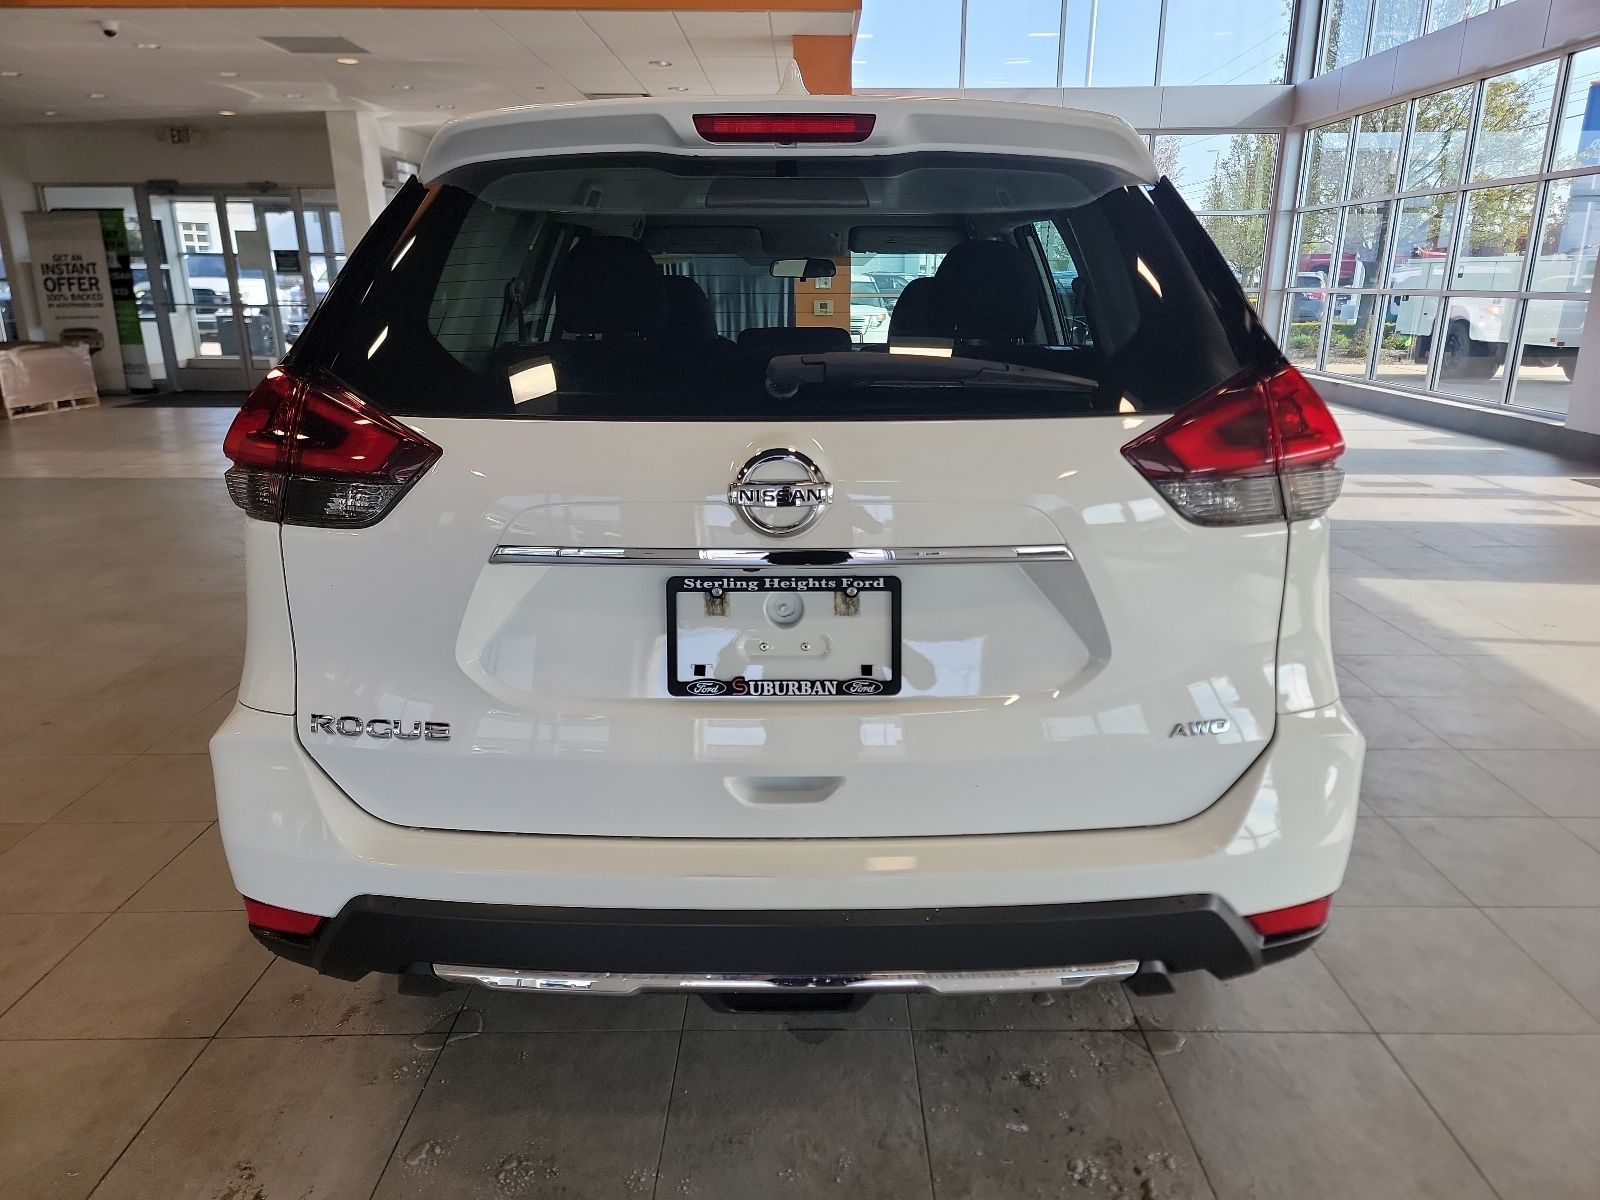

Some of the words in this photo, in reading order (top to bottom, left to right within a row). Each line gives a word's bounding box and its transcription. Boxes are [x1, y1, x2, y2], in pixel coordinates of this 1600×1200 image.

[40, 262, 97, 275] INSTANT
[43, 277, 101, 292] OFFER
[739, 488, 822, 503] NISSAN
[683, 578, 759, 590] Sterling
[763, 578, 836, 590] Heights
[841, 577, 885, 588] Ford
[691, 682, 721, 694] Ford
[732, 676, 838, 696] SUBURBAN
[848, 682, 877, 694] Ford
[310, 714, 451, 741] ROGUE
[1168, 718, 1231, 738] AWD
